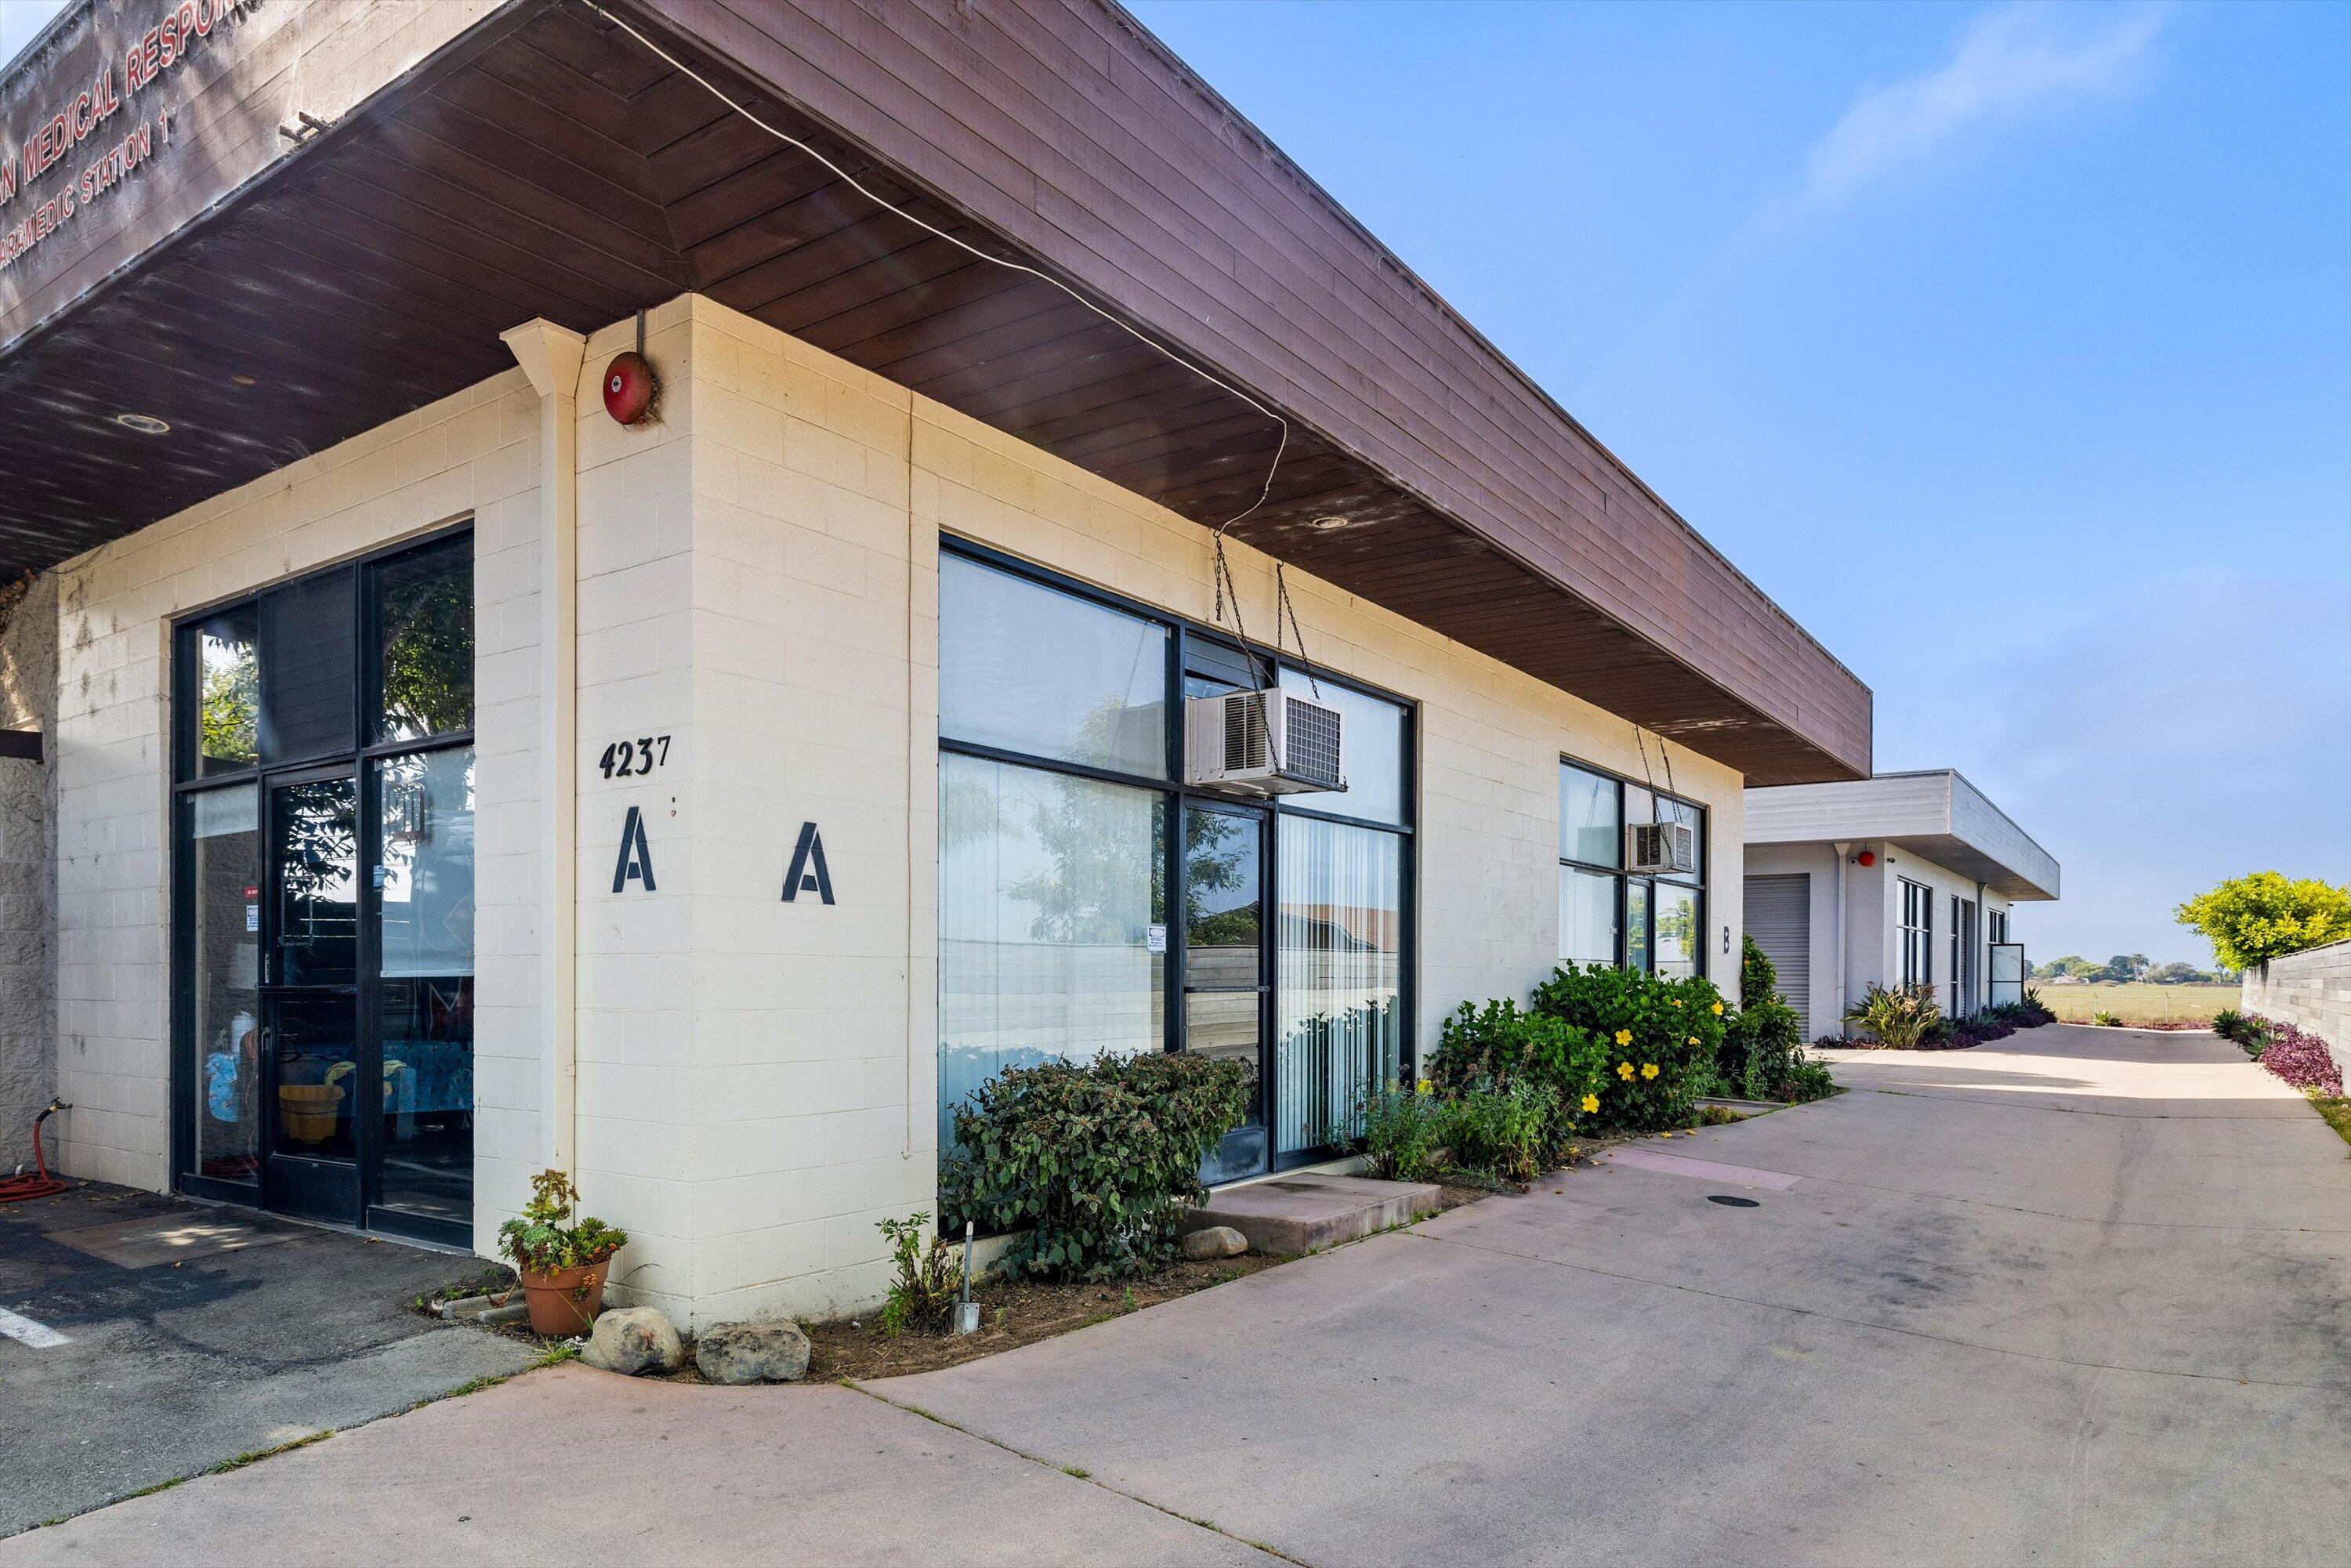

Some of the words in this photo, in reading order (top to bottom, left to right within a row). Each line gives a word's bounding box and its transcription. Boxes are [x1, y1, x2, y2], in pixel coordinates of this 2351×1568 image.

[0, 155, 16, 205] N
[24, 71, 118, 185] MEDICAL
[81, 123, 151, 204] STATION
[159, 109, 168, 143] 1
[599, 735, 672, 780] 4237
[612, 806, 657, 893] A
[781, 821, 836, 906] A
[1723, 925, 1730, 954] B
